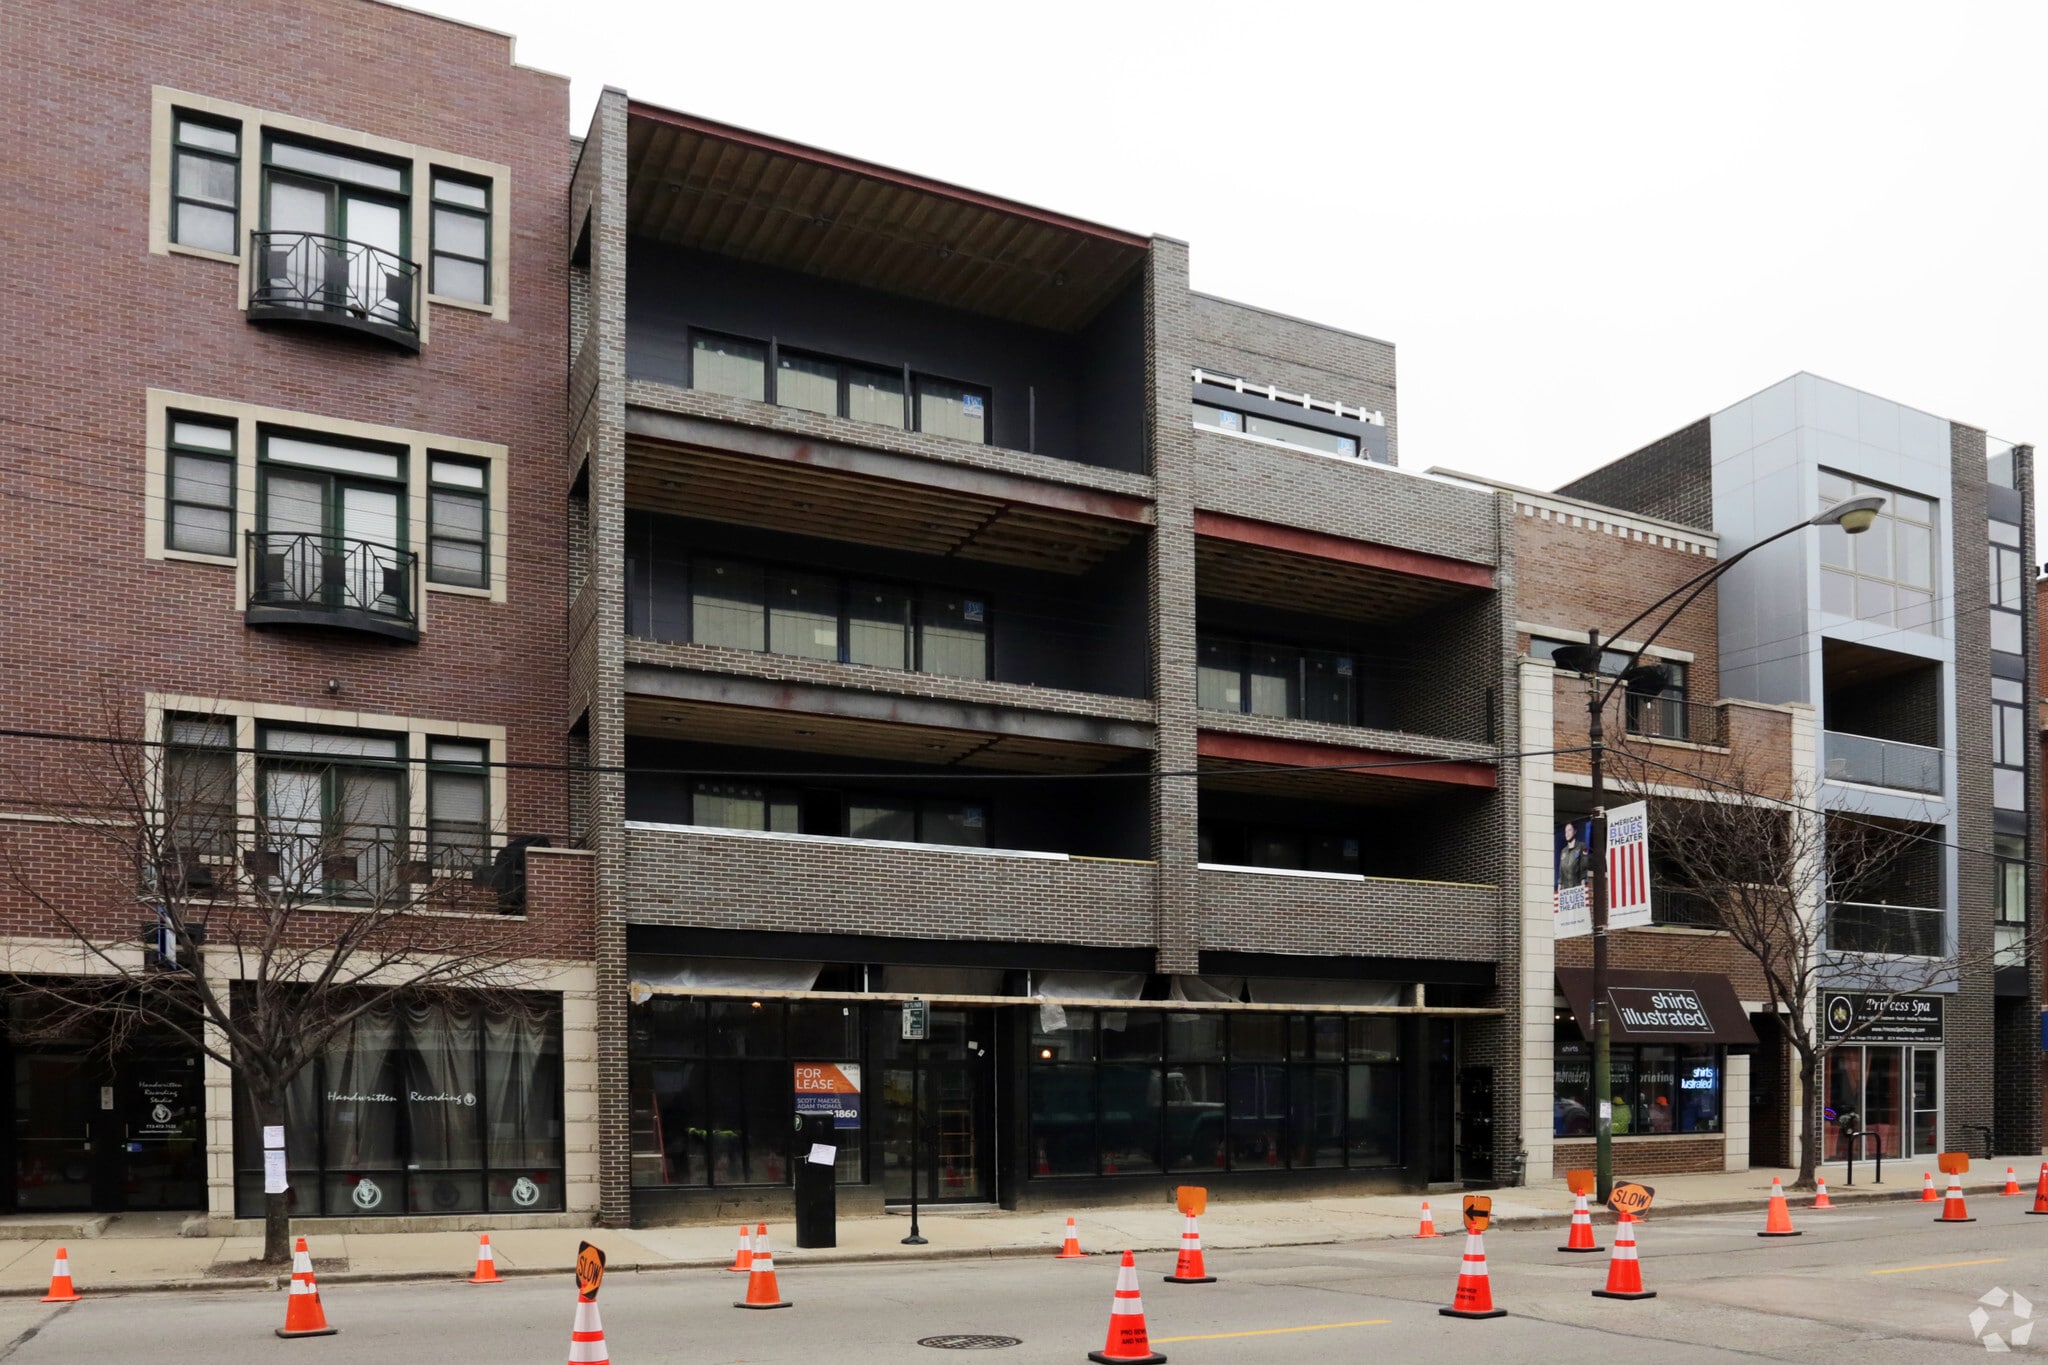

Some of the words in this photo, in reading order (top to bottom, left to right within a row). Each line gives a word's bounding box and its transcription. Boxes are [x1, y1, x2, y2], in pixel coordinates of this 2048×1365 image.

[1609, 815, 1643, 828] AMERICAN
[1609, 821, 1643, 838] BLUES
[1610, 832, 1643, 846] THEATER
[1560, 887, 1584, 897] AMERICAN
[1560, 893, 1585, 905] BLUES
[1560, 901, 1585, 912] THEATER
[1652, 992, 1698, 1010] shirts
[1912, 999, 1930, 1015] Spa
[1621, 1008, 1706, 1026] illustrated
[1562, 1045, 1578, 1053] shirts
[796, 1068, 821, 1078] FOR
[1693, 1067, 1713, 1078] shirts
[796, 1079, 834, 1090] LEASE
[144, 1088, 178, 1097] Recording
[327, 1091, 397, 1102] Handwritten
[410, 1091, 462, 1105] Recording
[1613, 1189, 1649, 1208] SLOW
[578, 1256, 601, 1287] SLOW
